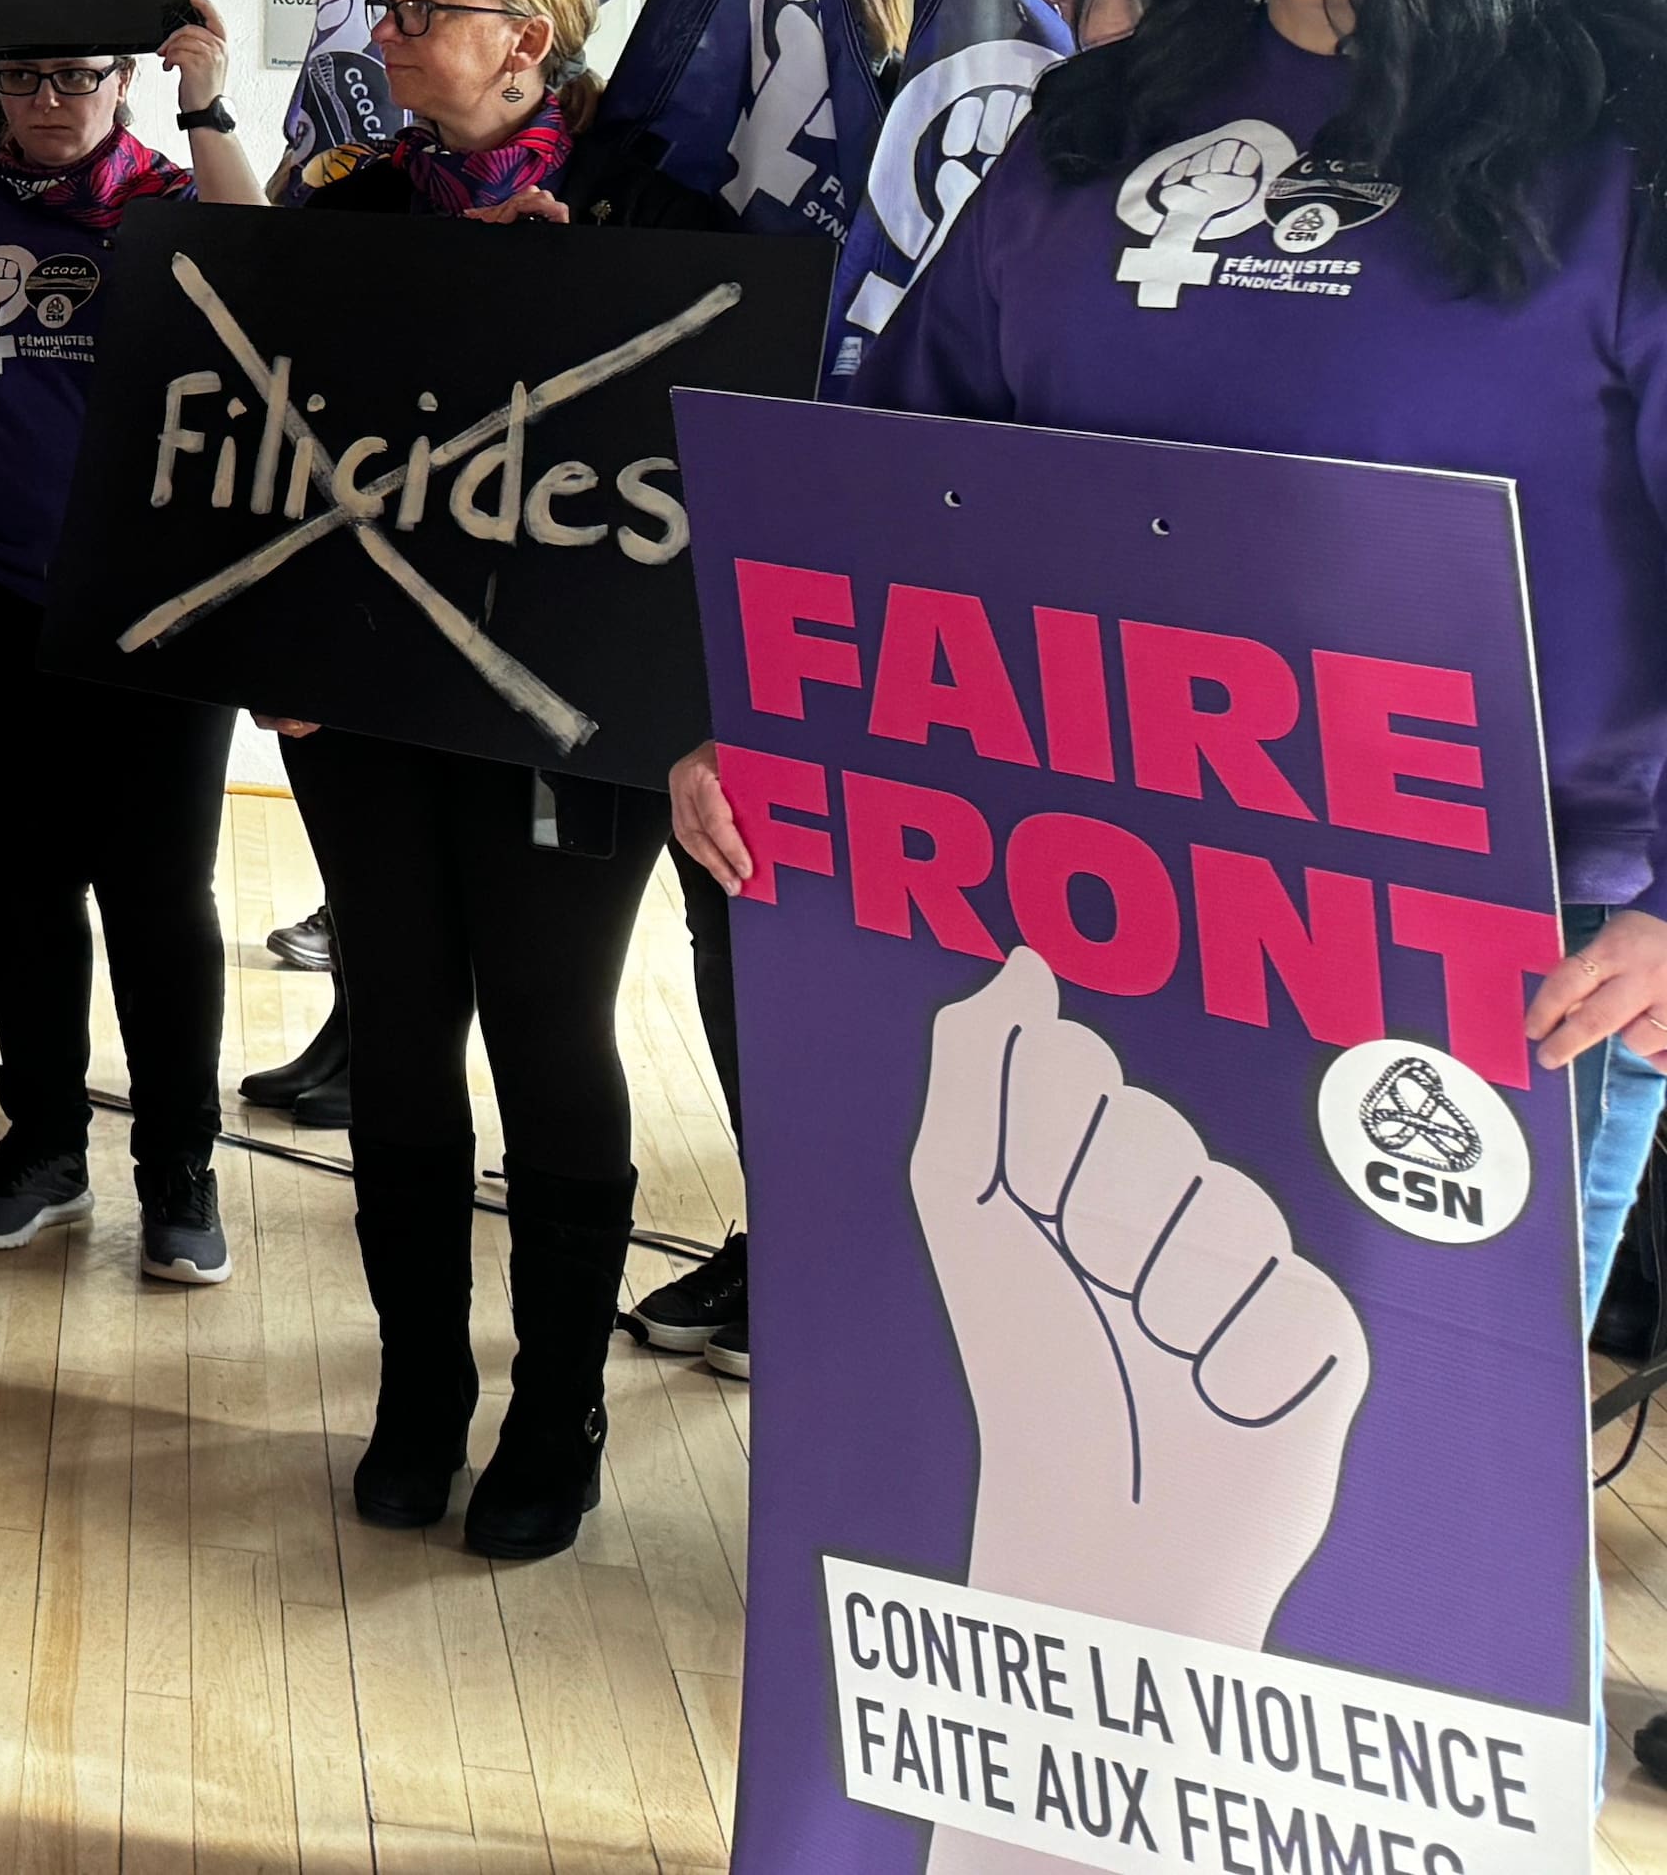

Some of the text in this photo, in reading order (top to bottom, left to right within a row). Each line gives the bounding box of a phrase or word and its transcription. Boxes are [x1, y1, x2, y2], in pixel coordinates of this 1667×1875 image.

[41, 266, 88, 276] CCQCA
[1218, 273, 1352, 297] SYNDICALISTES
[1222, 255, 1362, 275] FÉMINISTES
[1284, 231, 1318, 242] CSN
[150, 356, 690, 566] Filicides
[734, 557, 1491, 854] FAIRE
[715, 742, 1566, 1090] FRONT
[1365, 1161, 1484, 1226] CSN
[845, 1590, 1536, 1834] CONTRE LA VIOLENCE
[856, 1696, 1016, 1813] FAITE
[1035, 1744, 1159, 1853] AUX
